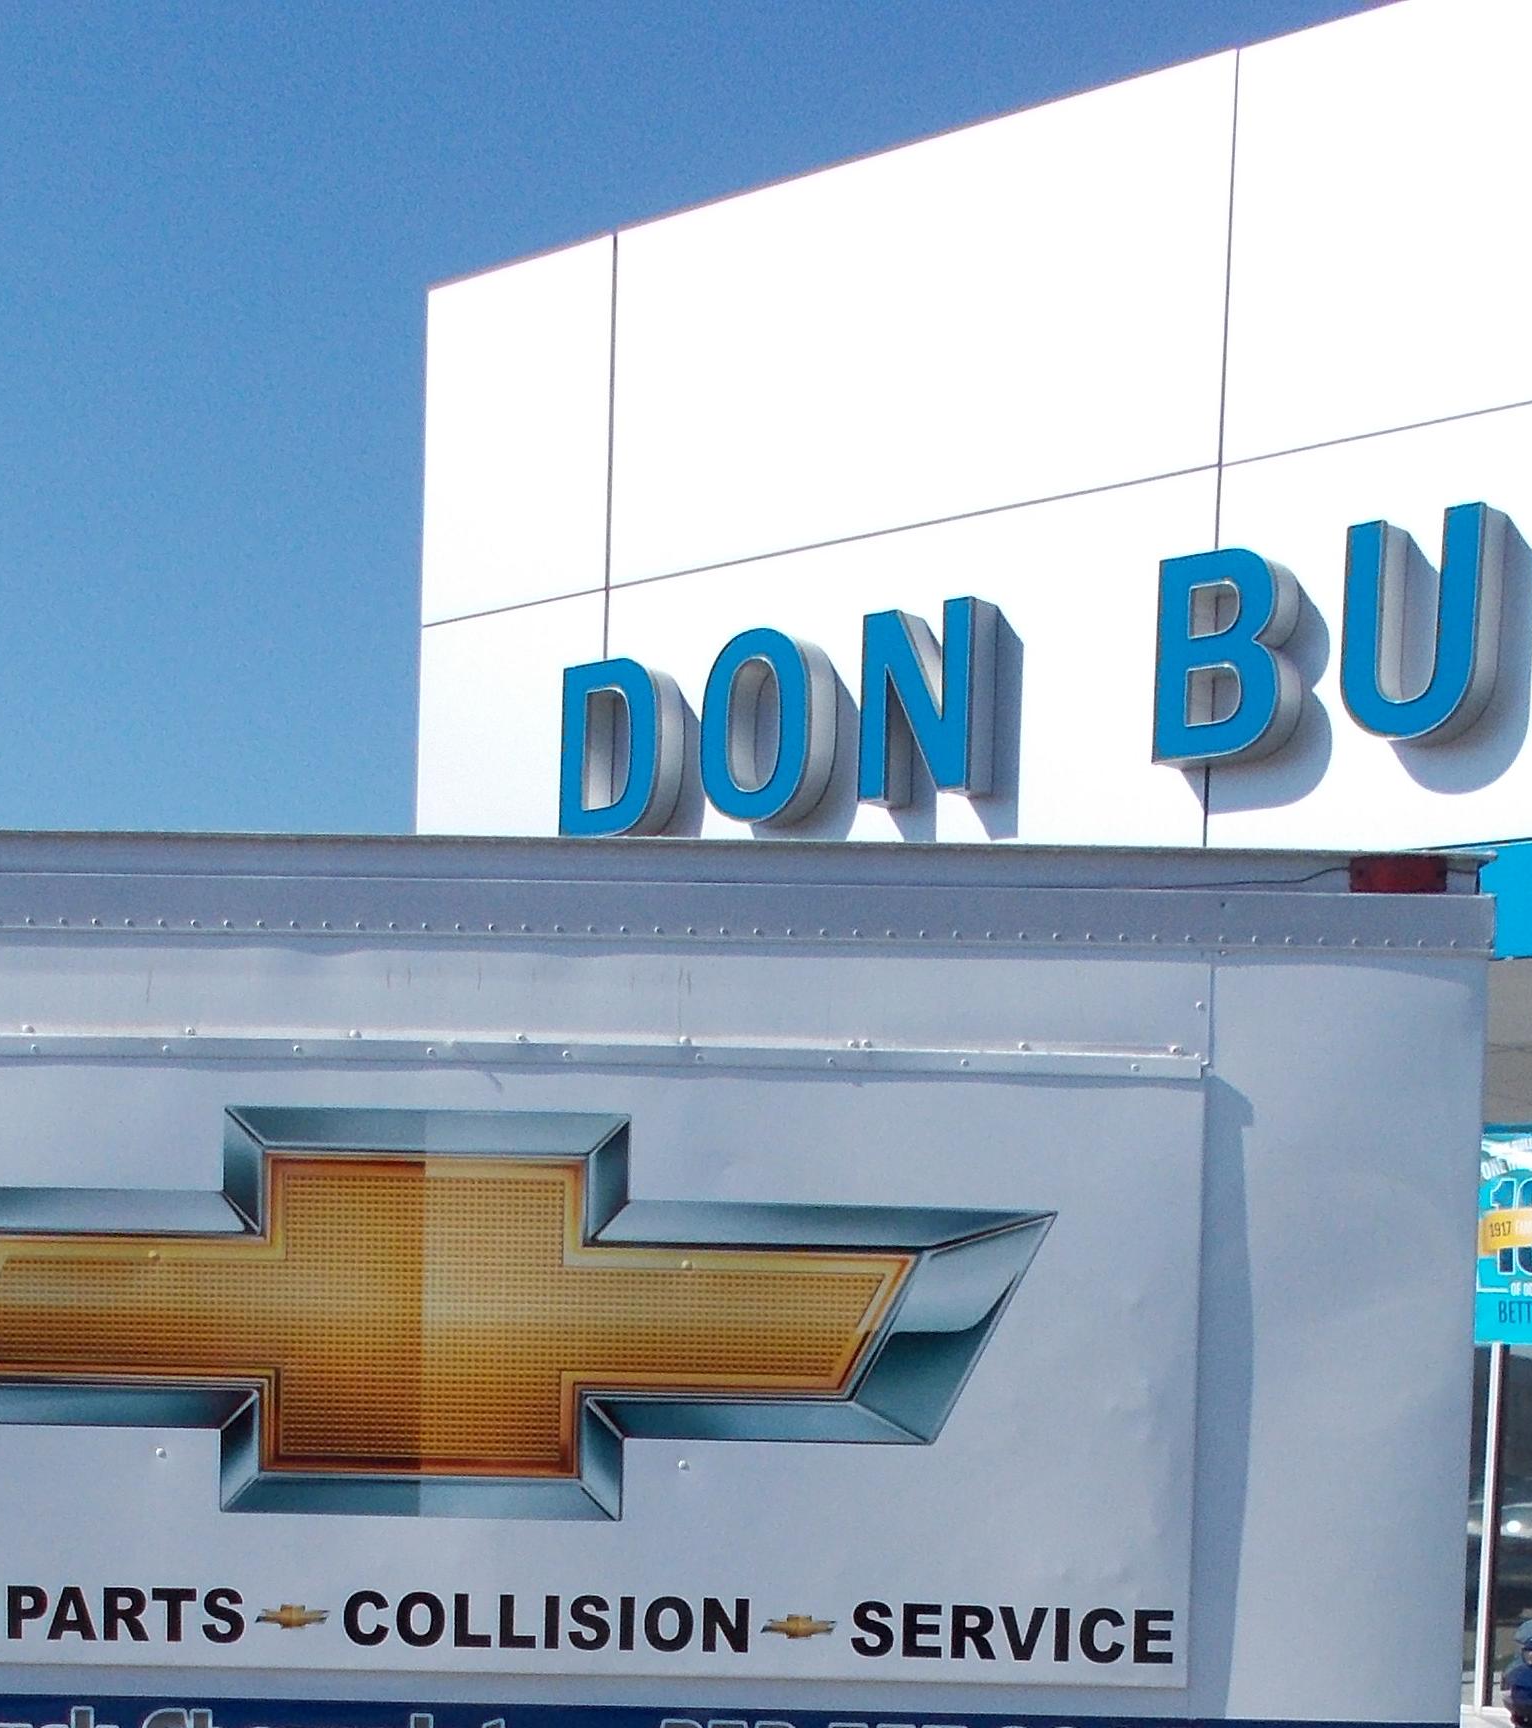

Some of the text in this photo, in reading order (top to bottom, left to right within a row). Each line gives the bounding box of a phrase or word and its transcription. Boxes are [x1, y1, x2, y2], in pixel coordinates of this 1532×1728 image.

[559, 594, 980, 838] DON
[1489, 1221, 1512, 1237] 1917
[6, 1585, 245, 1645] PARTS
[342, 1589, 750, 1655] COLLISION
[850, 1602, 1174, 1666] SERVICE
